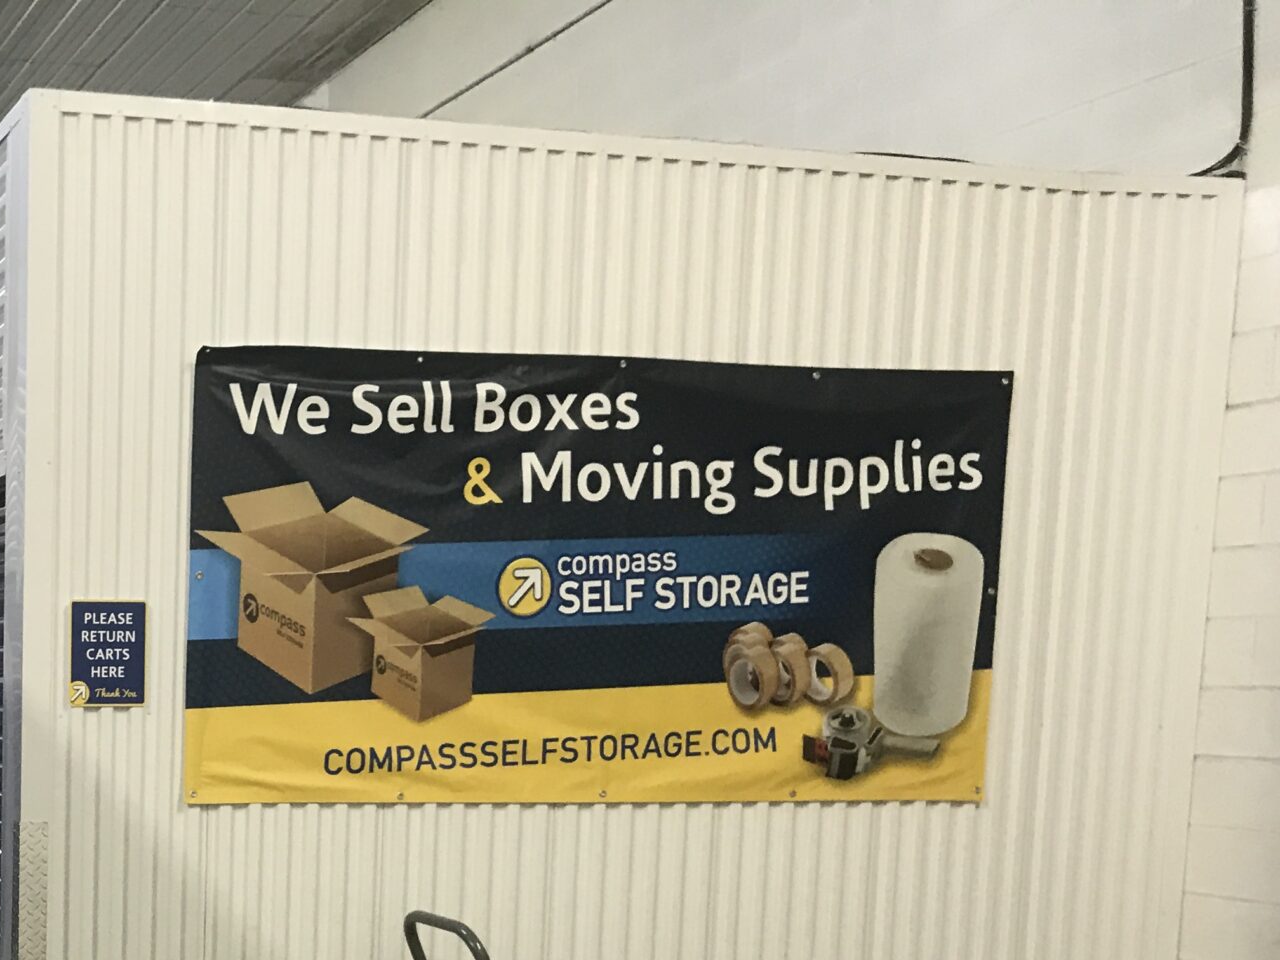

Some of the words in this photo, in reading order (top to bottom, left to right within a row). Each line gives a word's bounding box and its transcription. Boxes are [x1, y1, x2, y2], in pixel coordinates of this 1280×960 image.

[229, 382, 330, 435] We
[350, 380, 454, 435] Sell
[474, 381, 640, 433] Boxes
[463, 457, 504, 505] &
[521, 444, 736, 515] Moving
[753, 438, 983, 511] Supplies
[557, 551, 677, 581] compass
[558, 578, 645, 615] SELF
[654, 570, 810, 610] STORAGE
[84, 612, 134, 625] PLEASE
[260, 603, 306, 637] compass
[81, 630, 136, 643] RETURN
[86, 648, 130, 660] CARTS
[90, 666, 125, 678] HERE
[94, 687, 121, 698] Thank
[121, 688, 138, 698] You
[323, 726, 777, 776] COMPASSSELFSTORAGE.COM
